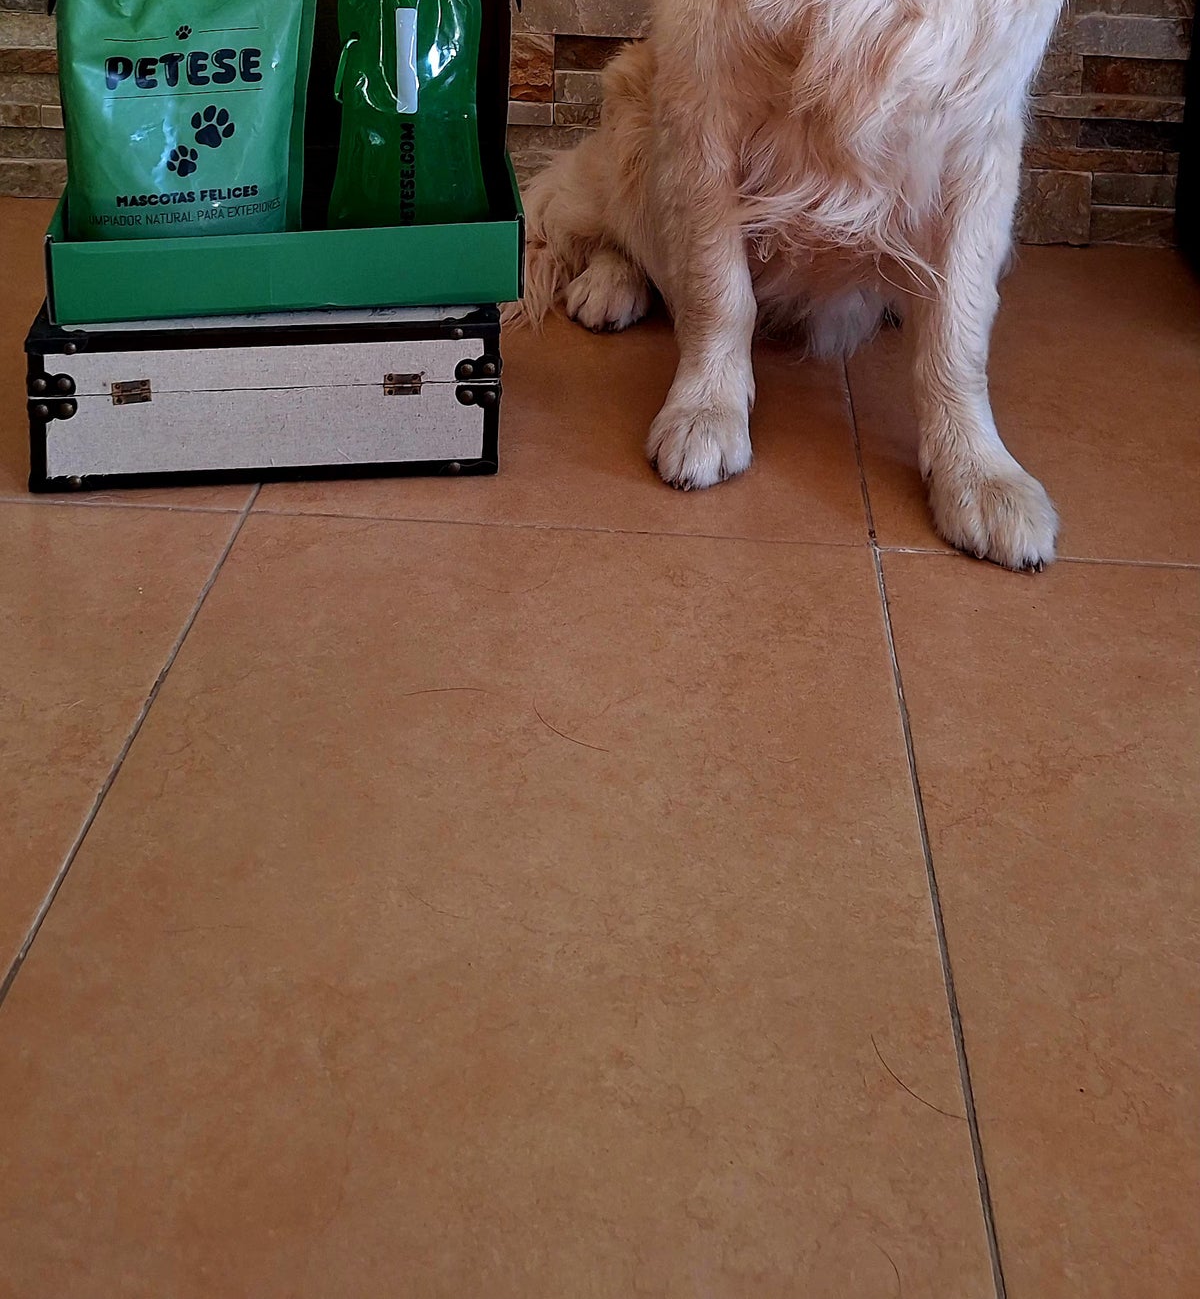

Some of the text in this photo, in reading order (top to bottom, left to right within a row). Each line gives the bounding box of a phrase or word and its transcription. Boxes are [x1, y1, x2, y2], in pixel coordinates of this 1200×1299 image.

[104, 48, 262, 90] PETESE
[116, 185, 259, 208] MASCOTAS FELICES
[145, 211, 194, 225] NATURAL
[197, 209, 225, 220] PARA
[227, 198, 280, 218] EXTERIORES
